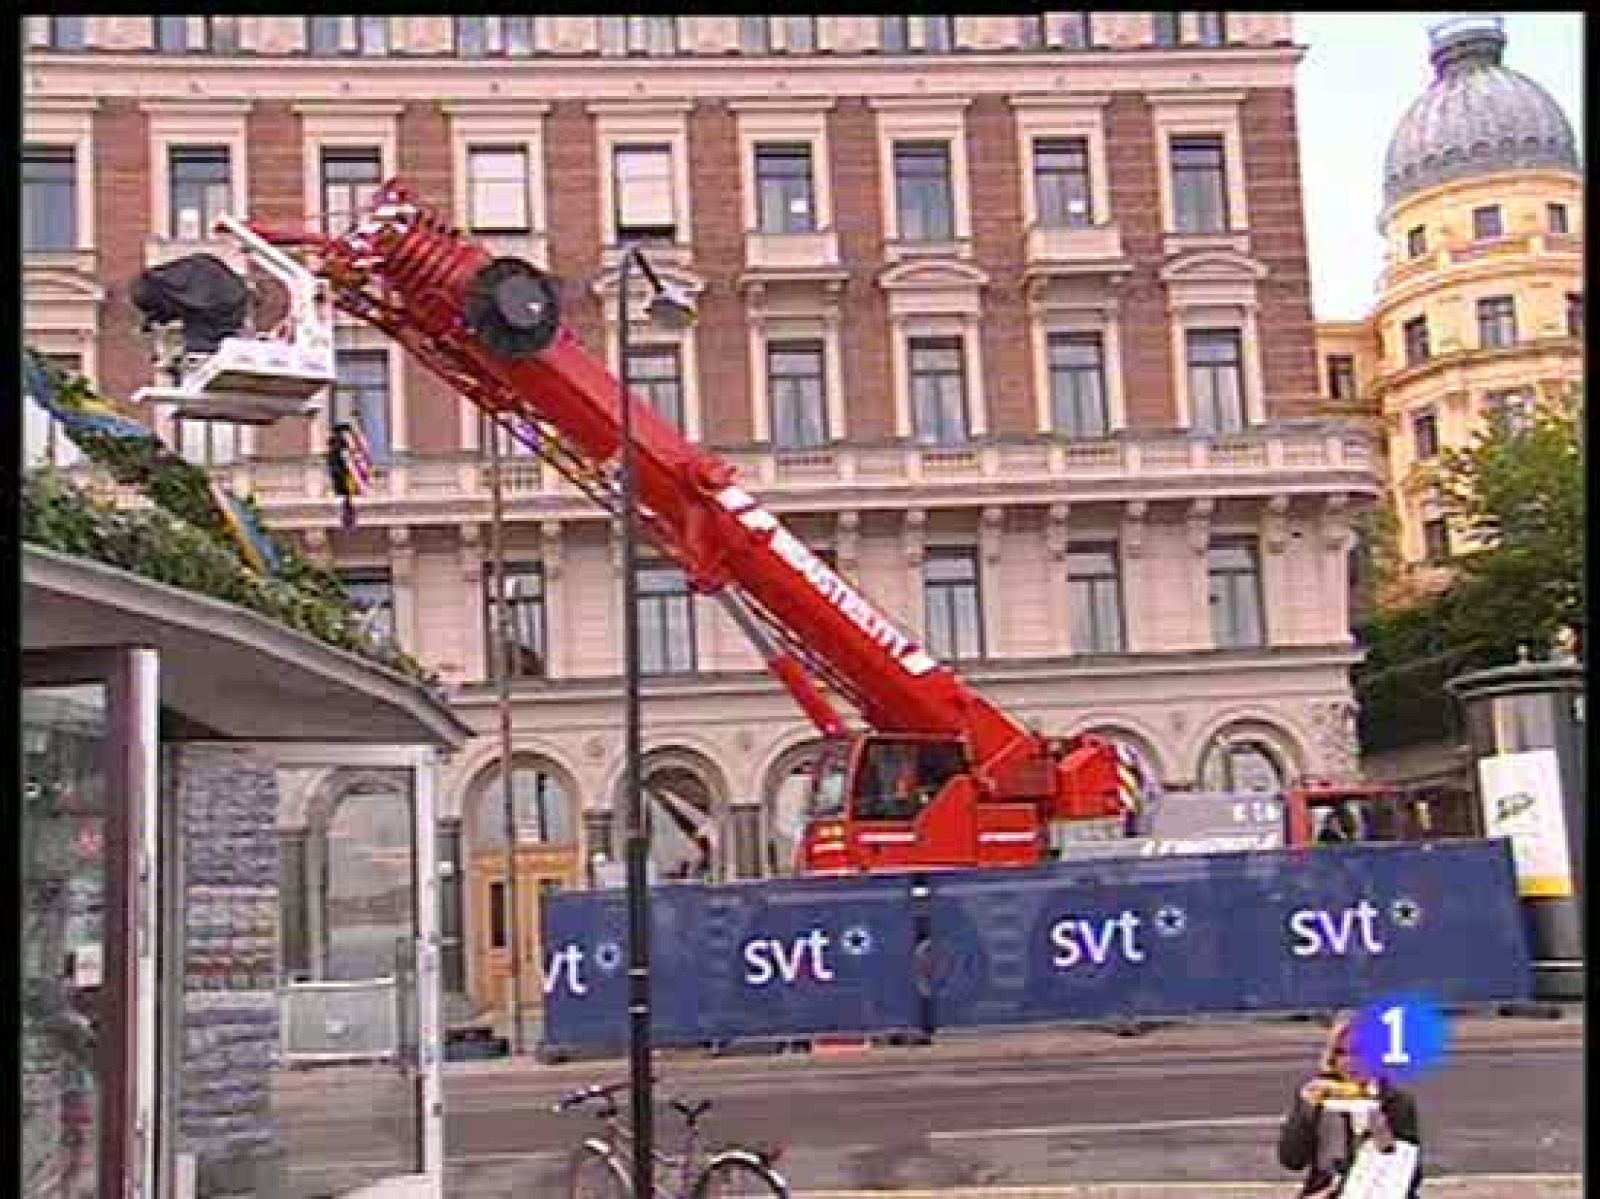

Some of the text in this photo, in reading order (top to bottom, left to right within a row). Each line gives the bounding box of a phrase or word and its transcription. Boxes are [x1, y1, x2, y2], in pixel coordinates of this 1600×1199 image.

[1051, 910, 1144, 967] svt
[1290, 900, 1384, 955] svt
[744, 928, 834, 985] svt
